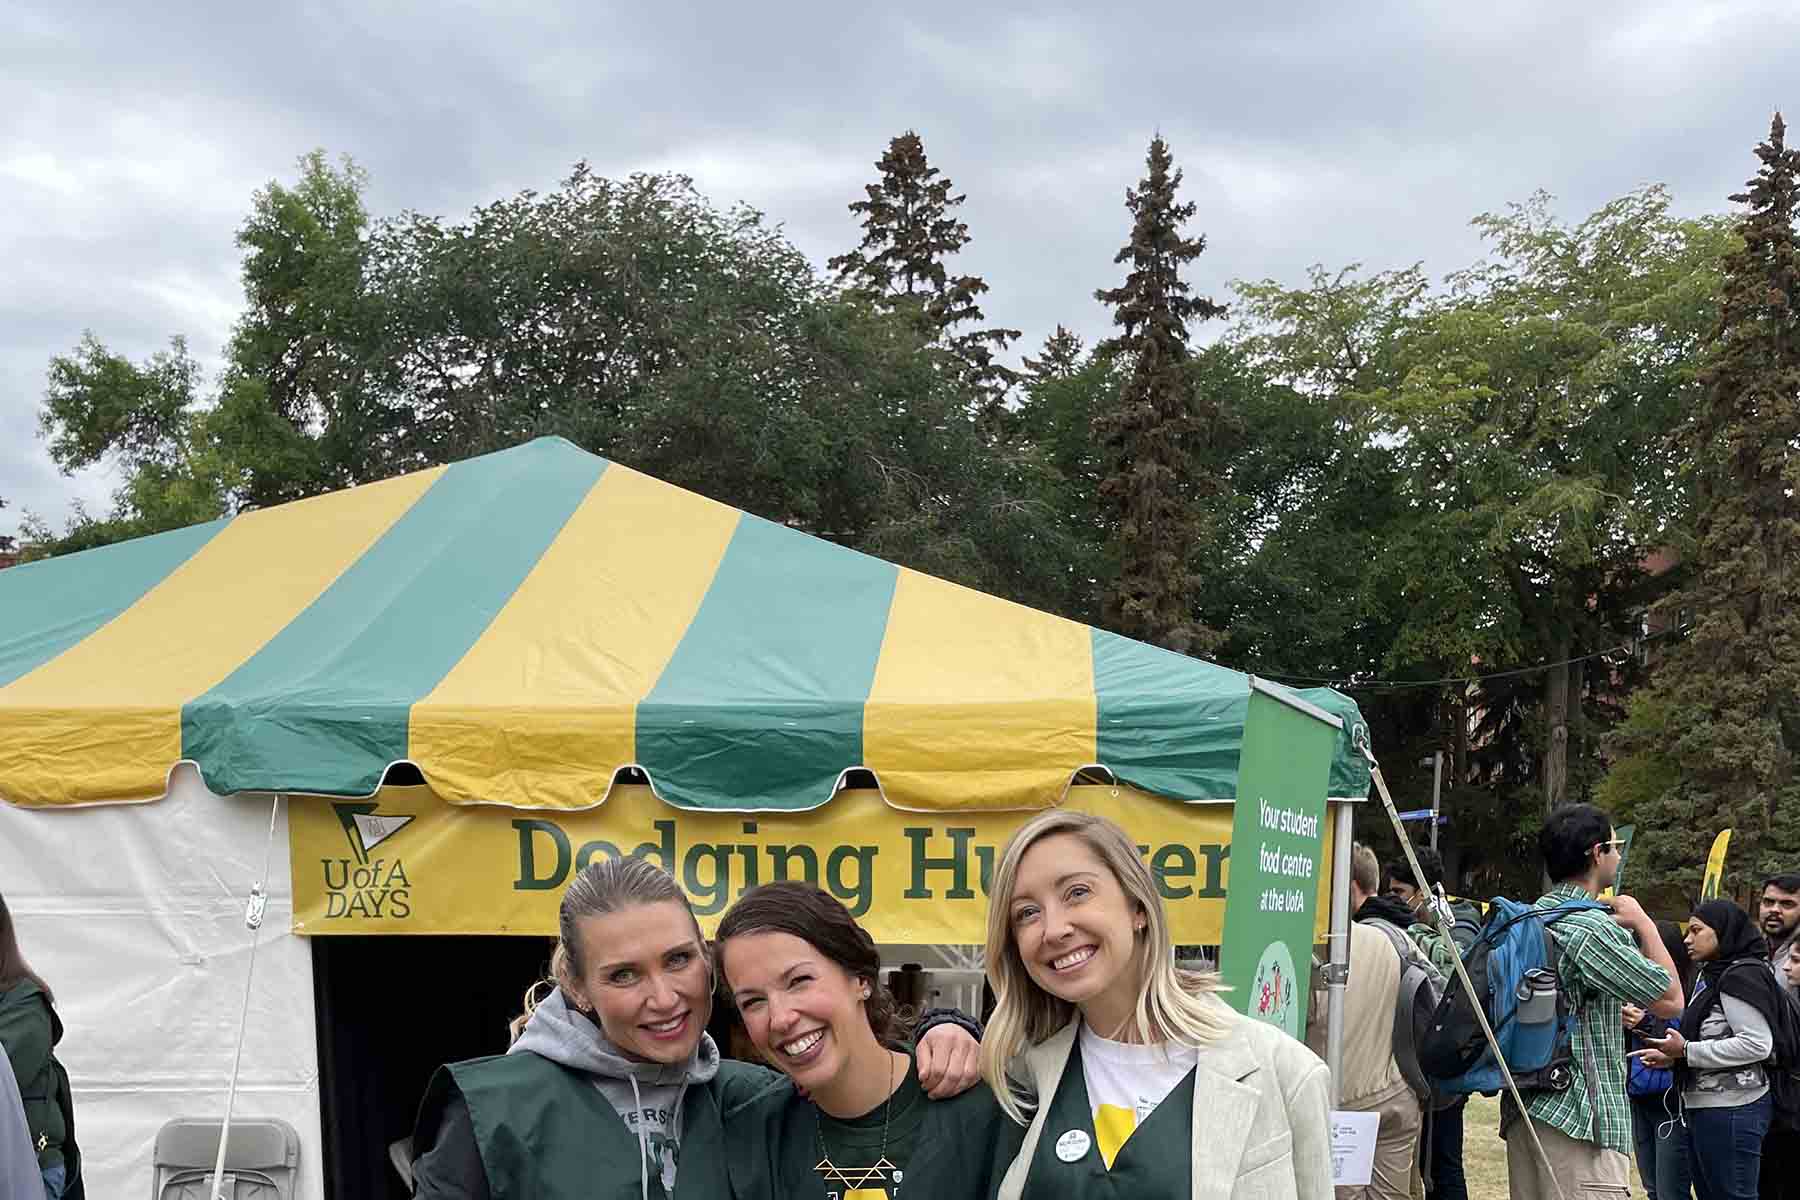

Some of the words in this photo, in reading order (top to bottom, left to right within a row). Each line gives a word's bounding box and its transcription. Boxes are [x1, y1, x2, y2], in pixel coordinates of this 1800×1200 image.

[1259, 797, 1280, 830] Your
[1280, 807, 1318, 839] student
[1259, 841, 1280, 874] food
[1282, 852, 1313, 878] centre
[325, 890, 410, 919] DAYS
[1260, 890, 1268, 911] at
[1269, 887, 1284, 911] the
